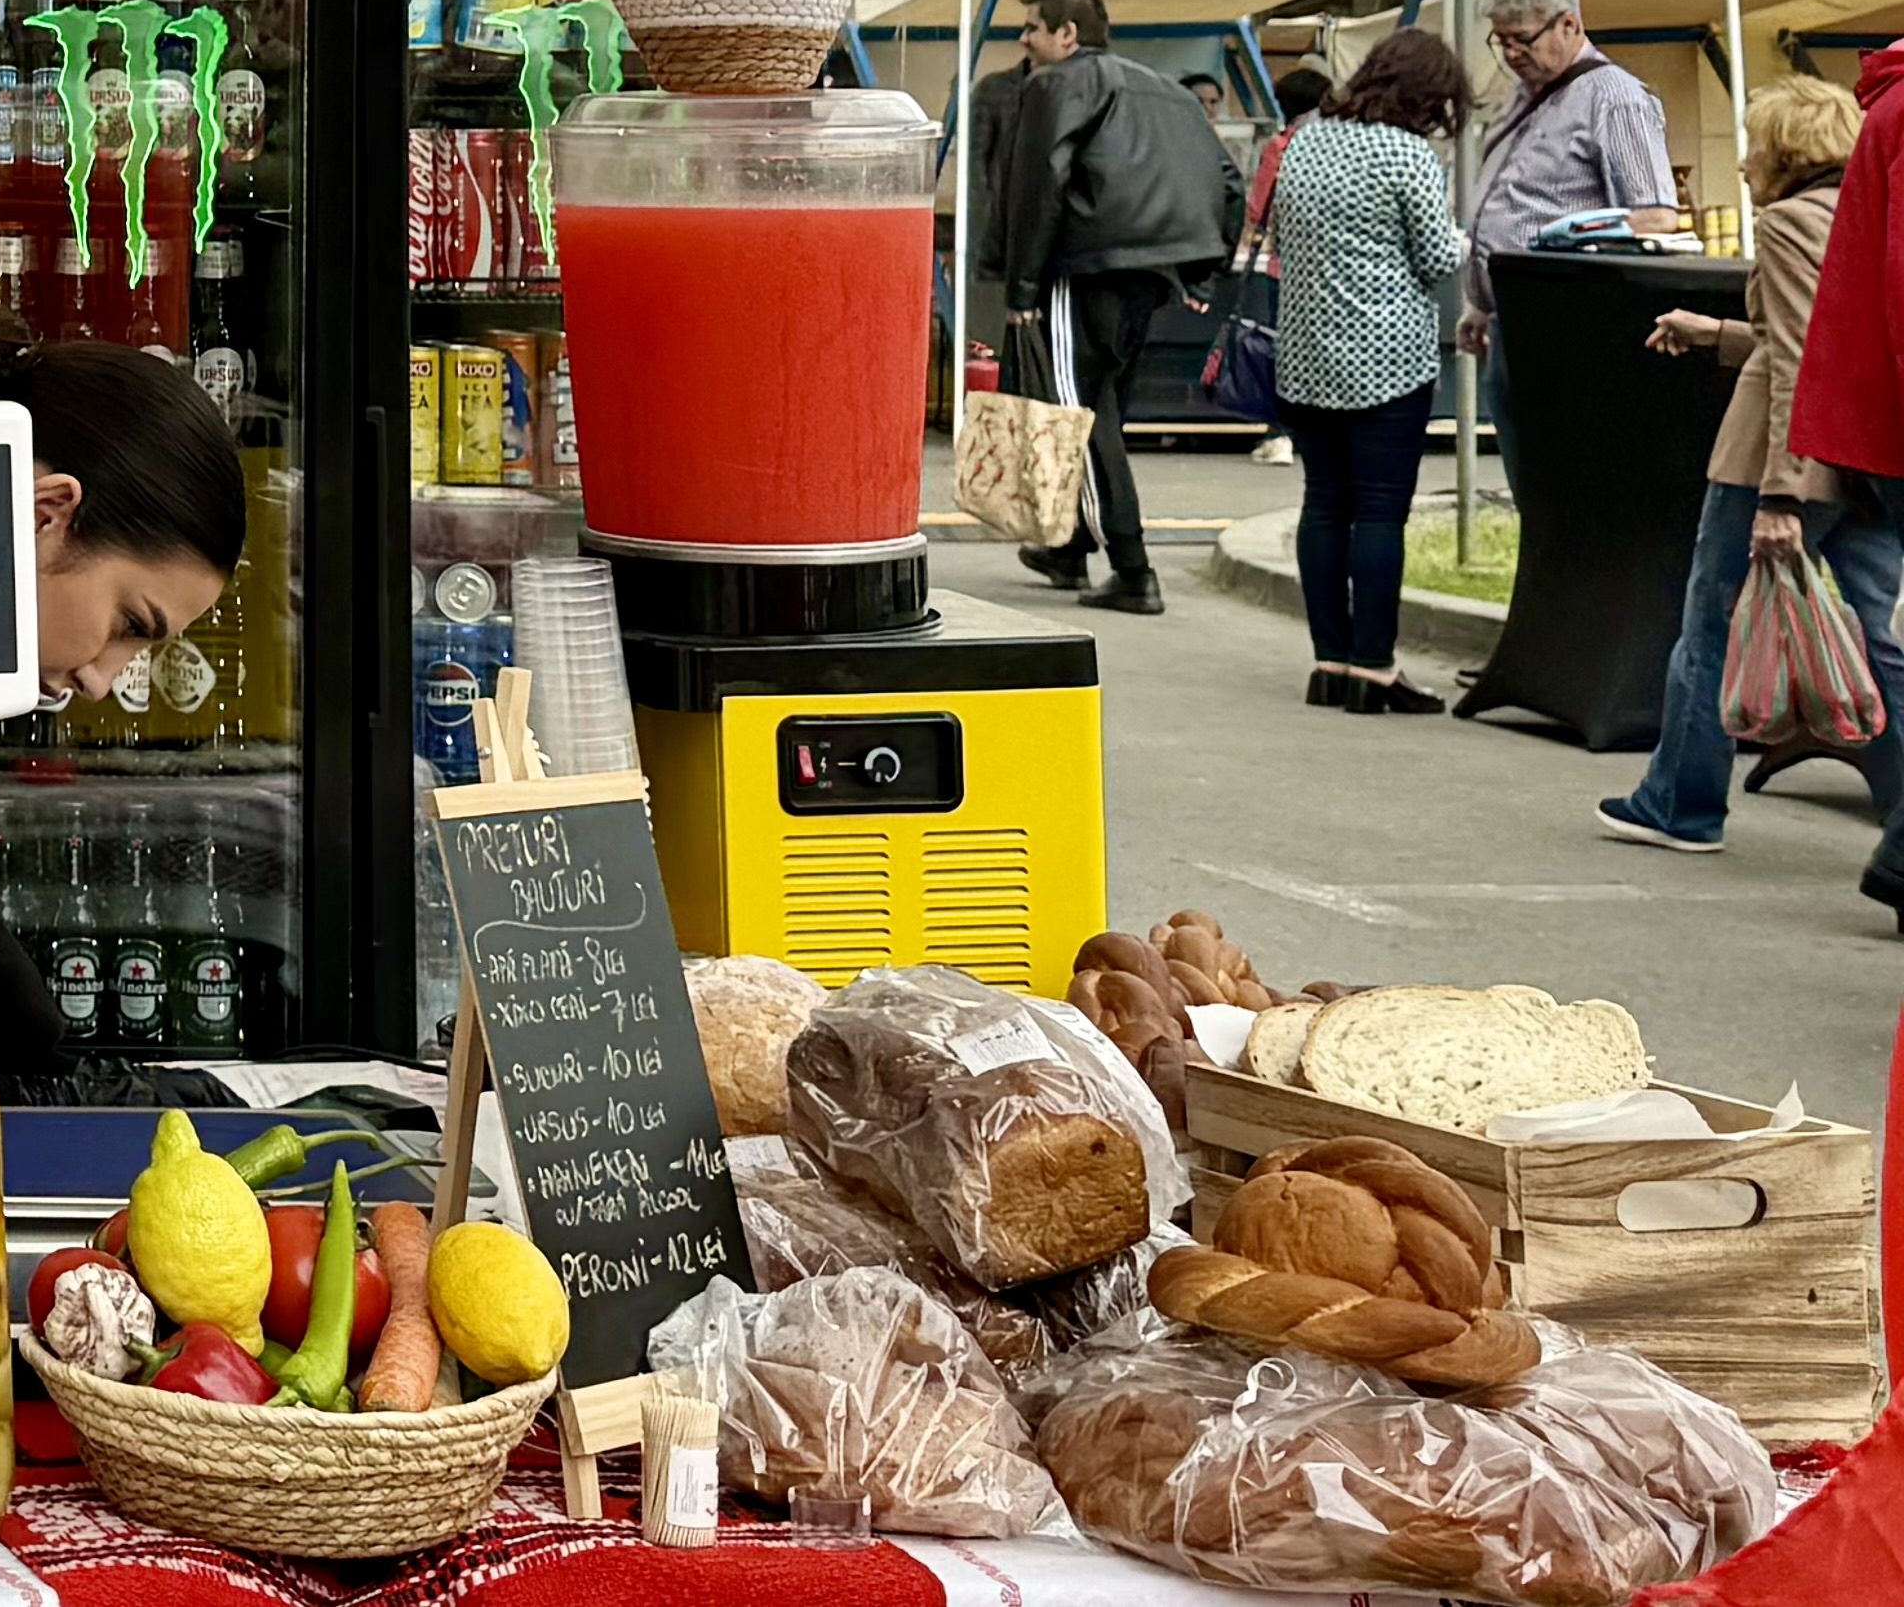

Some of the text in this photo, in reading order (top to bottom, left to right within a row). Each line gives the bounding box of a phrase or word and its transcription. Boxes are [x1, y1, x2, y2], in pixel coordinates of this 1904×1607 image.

[602, 989, 627, 1034] 7
[630, 984, 659, 1023] LEI
[602, 1043, 632, 1082] 10
[635, 1035, 663, 1077] LEI
[523, 1106, 589, 1144] URSUS
[608, 1096, 635, 1136] 10
[640, 1101, 666, 1130] LEI
[561, 1237, 650, 1298] PERONI
[668, 1232, 696, 1274] 12
